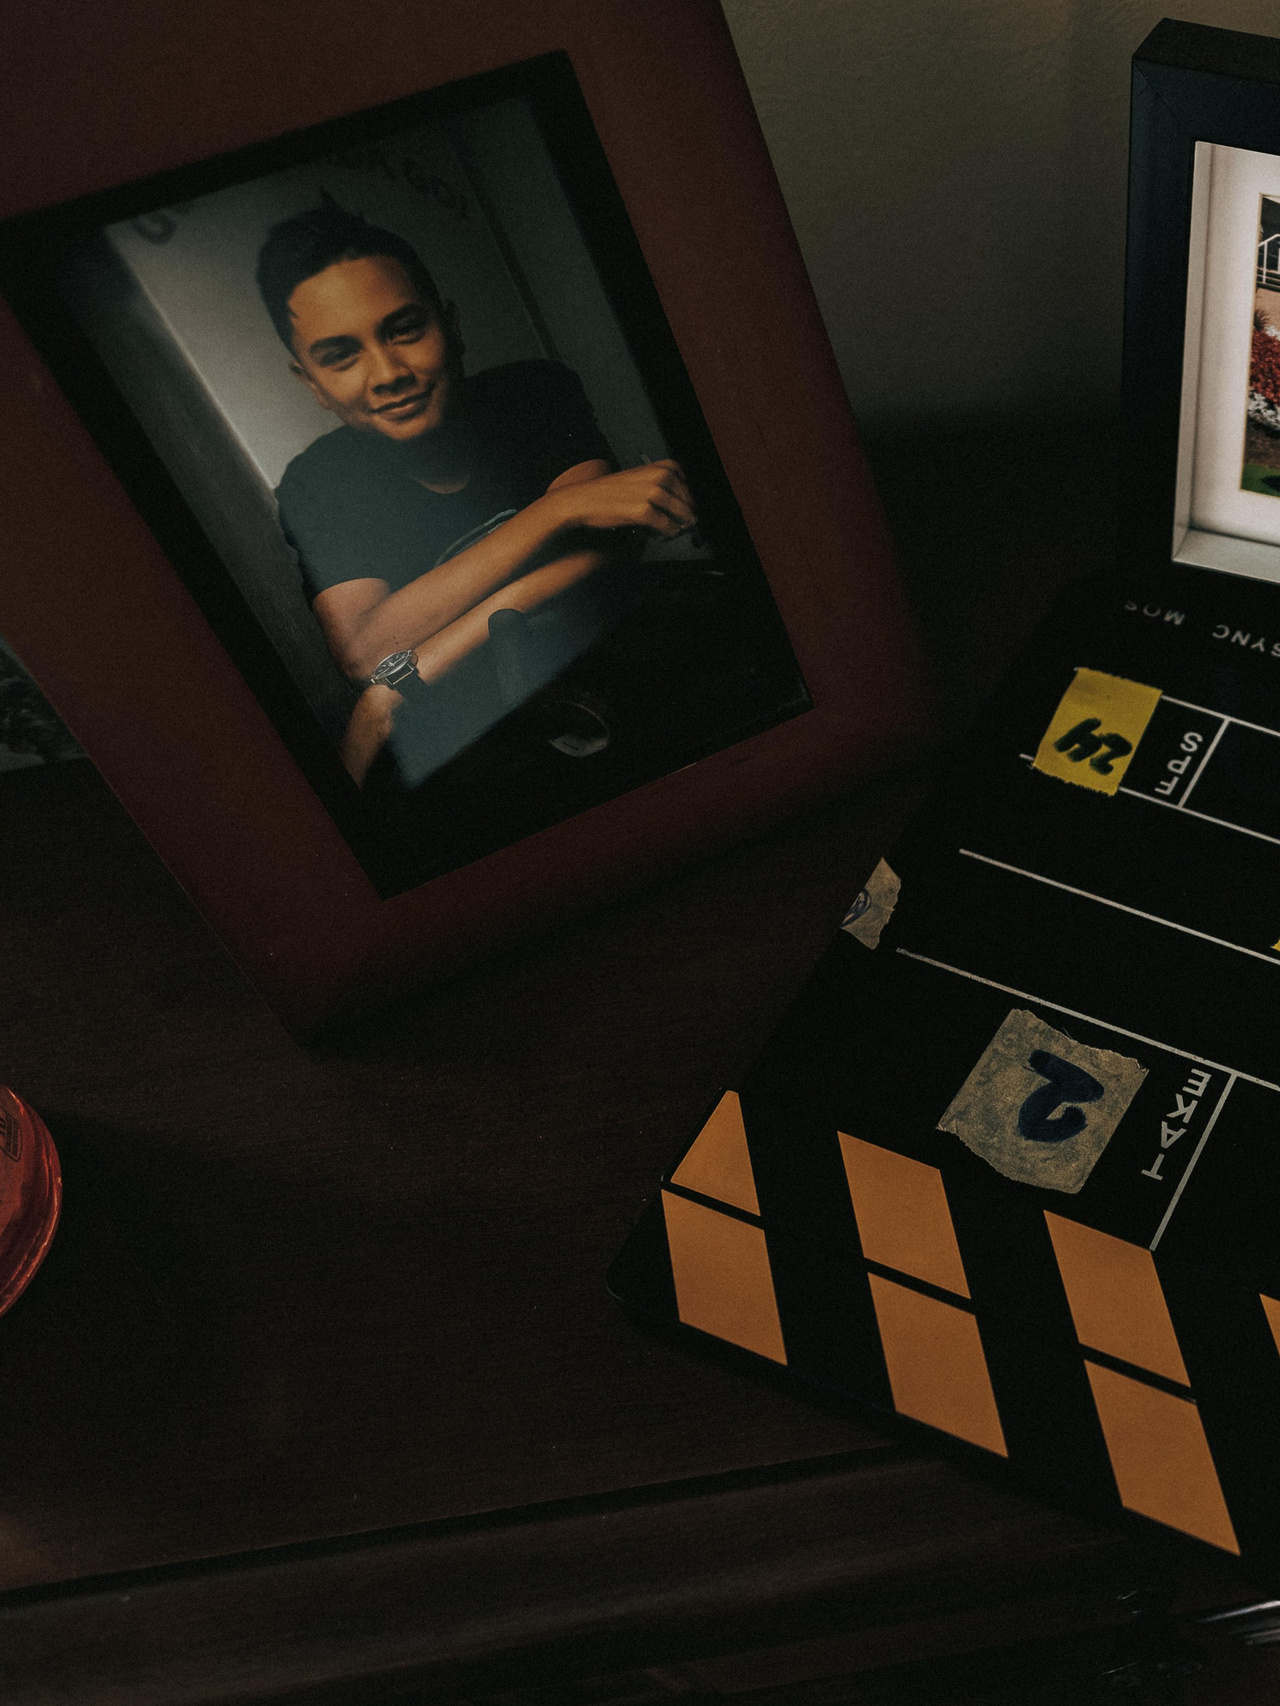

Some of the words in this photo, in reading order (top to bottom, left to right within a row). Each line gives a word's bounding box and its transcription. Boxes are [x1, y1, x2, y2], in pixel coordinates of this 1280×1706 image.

[1053, 717, 1133, 776] 24
[1153, 730, 1204, 796] FPS
[1017, 1049, 1105, 1144] 2
[1140, 1067, 1213, 1182] TAKE
